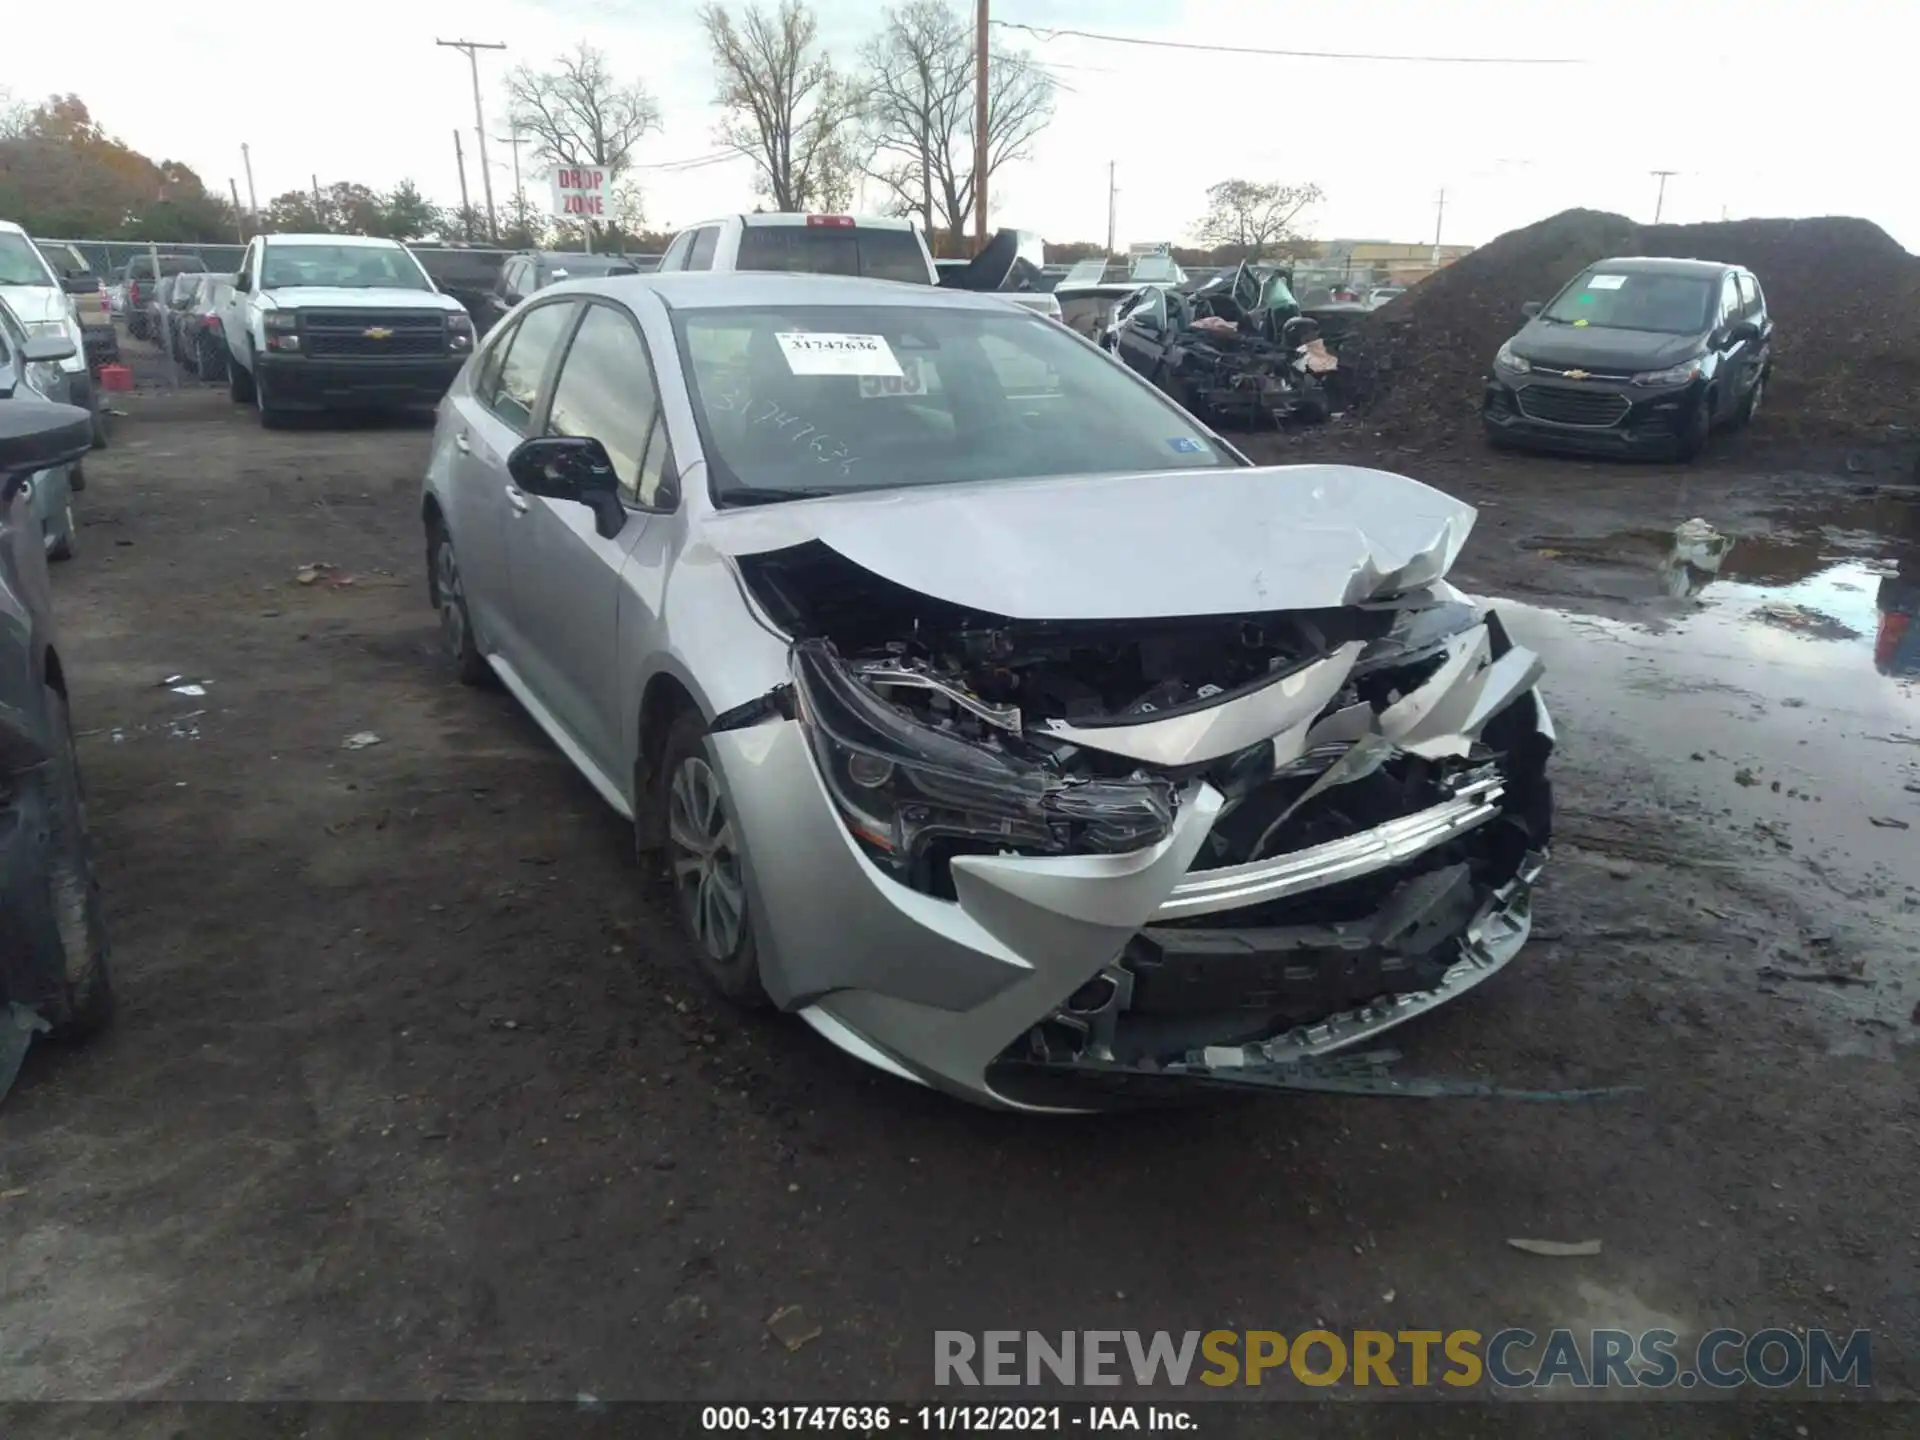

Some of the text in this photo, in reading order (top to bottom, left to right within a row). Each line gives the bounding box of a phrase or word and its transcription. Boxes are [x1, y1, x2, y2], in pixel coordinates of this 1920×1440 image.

[559, 168, 604, 190] DROP
[562, 194, 604, 215] ZONE
[791, 339, 879, 352] 31747636
